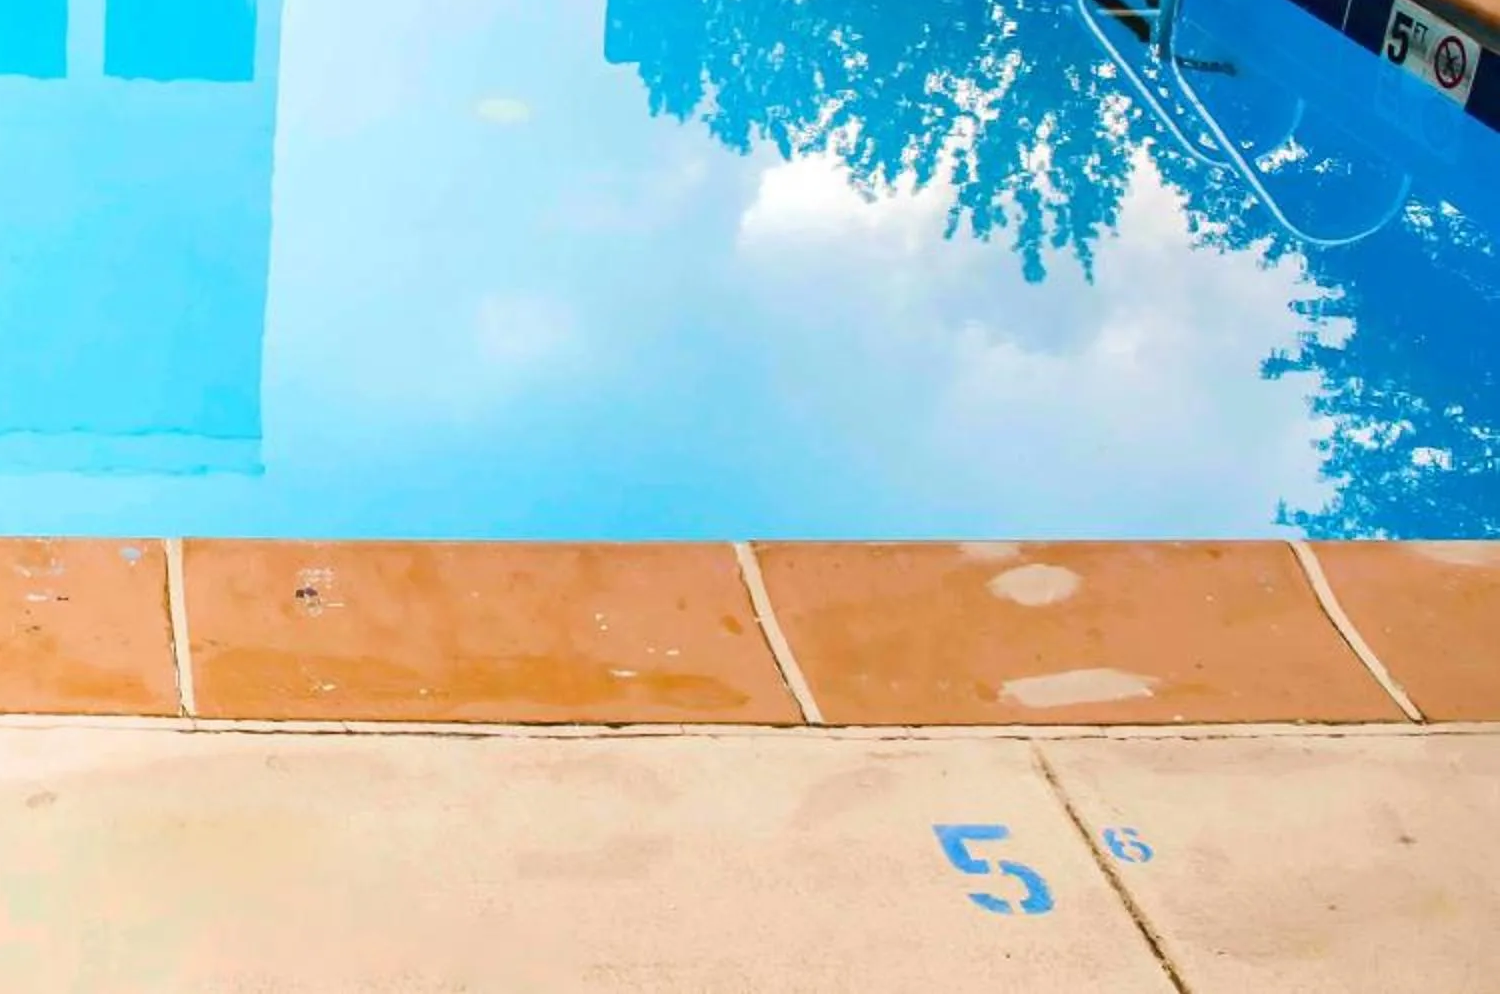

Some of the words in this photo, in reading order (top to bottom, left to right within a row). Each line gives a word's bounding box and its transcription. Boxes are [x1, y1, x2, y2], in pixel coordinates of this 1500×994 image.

[1387, 10, 1414, 66] 5
[932, 823, 1055, 915] 5
[1101, 827, 1154, 863] 6
